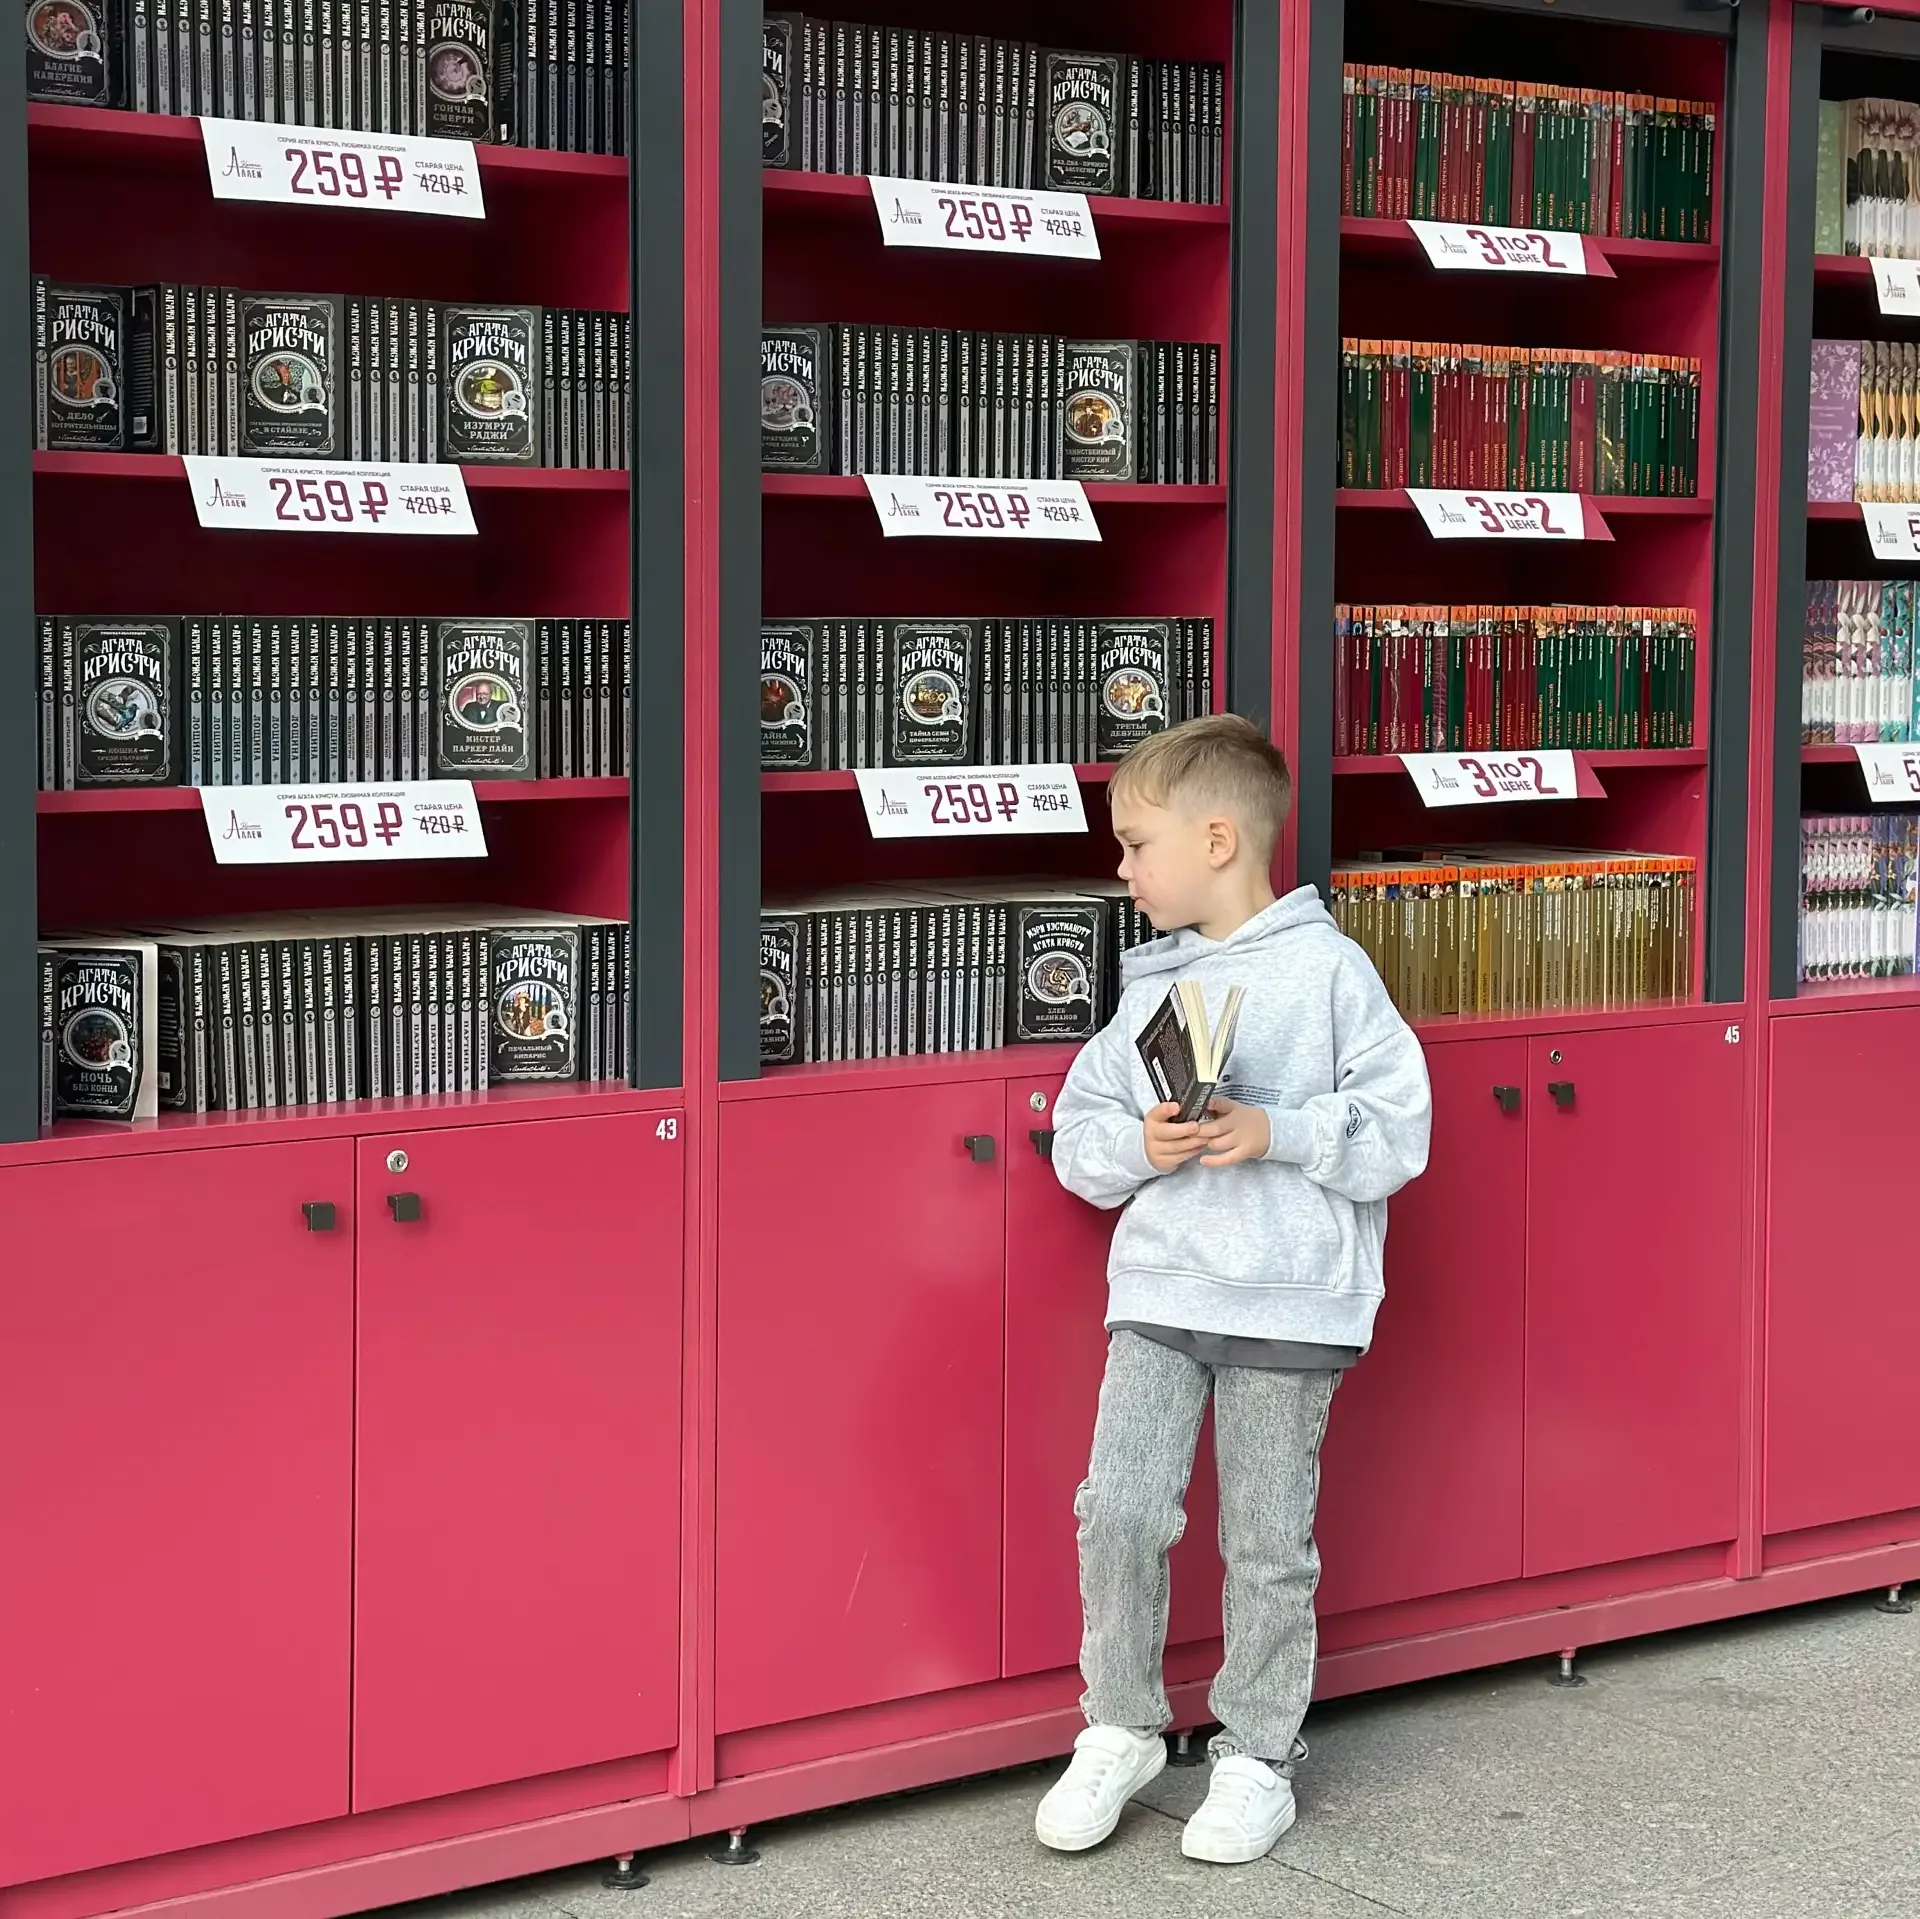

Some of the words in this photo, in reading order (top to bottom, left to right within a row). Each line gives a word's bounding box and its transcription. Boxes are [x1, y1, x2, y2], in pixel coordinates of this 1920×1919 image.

[436, 2, 472, 21] АГАТА
[430, 17, 486, 50] РИСТИ
[44, 60, 83, 74] БЛАГИЕ
[1065, 68, 1098, 82] АГАТА
[33, 70, 93, 86] НАМЕРЕНИЯ
[1053, 80, 1110, 108] КРИСТИ
[434, 102, 474, 116] ГОНЧАЯ
[433, 113, 475, 124] СМЕРТИ
[415, 161, 443, 170] СТАРАЯ
[444, 163, 464, 171] ЦЕНА
[1466, 229, 1506, 265] 3
[1526, 234, 1568, 268] 2
[1507, 252, 1542, 264] ЦЕНЕ
[58, 304, 99, 320] АГАТА
[166, 294, 175, 320] АГАТА
[266, 312, 308, 328] АГАТА
[51, 319, 116, 350] РИСТИ
[166, 322, 175, 354] КРИСТИ
[468, 322, 509, 338] АГАТА
[249, 325, 325, 357] КРИСТИ
[762, 339, 798, 354] АГАТА
[452, 334, 526, 365] КРИСТИ
[1072, 356, 1109, 370] АГАТА
[1066, 368, 1124, 394] РИСТИ
[67, 411, 94, 422] ДЕЛО
[464, 421, 514, 432] ИЗУМРУД
[470, 430, 508, 440] РАДЖИ
[1465, 496, 1504, 532] 3
[1524, 497, 1566, 534] 2
[1506, 519, 1540, 531] ЦЕНЕ
[101, 638, 144, 654] АГАТА
[192, 629, 201, 654] АГАТА
[290, 630, 300, 654] АГАТА
[464, 636, 504, 651] АГАТА
[761, 638, 790, 652] ГАТА
[916, 636, 950, 650] АГАТА
[1114, 636, 1148, 649] АГАТА
[84, 651, 160, 683] КРИСТИ
[447, 648, 520, 678] КРИСТИ
[902, 648, 964, 674] КРИСТИ
[1101, 646, 1162, 672] КРИСТИ
[192, 656, 201, 688] КРИСТИ
[290, 656, 300, 688] КРИСТИ
[192, 716, 200, 763] ЛОЩИНА
[466, 736, 502, 744] МИСТЕР
[108, 747, 138, 755] КОШКА
[452, 744, 488, 754] ПАРКЕР
[488, 744, 514, 753] ПАЙН
[1458, 758, 1498, 797] 3
[1518, 757, 1559, 794] 2
[1499, 780, 1533, 793] ЦЕНЕ
[1026, 924, 1046, 939] МЭРИ
[1046, 922, 1092, 938] УЭСТМАКОТТ
[512, 943, 552, 958] АГАТА
[1032, 938, 1056, 952] АГАТА
[1056, 937, 1084, 952] КРИСТИ
[412, 944, 420, 968] АГАТА
[479, 942, 488, 966] АГАТА
[78, 968, 118, 984] АГАТА
[496, 956, 569, 986] КРИСТИ
[412, 970, 420, 1001] КРИСТИ
[479, 968, 488, 998] КРИСТИ
[61, 982, 132, 1014] КРИСТИ
[1724, 1025, 1740, 1044] 45
[80, 1072, 113, 1084] НОЧЬ
[72, 1082, 89, 1092] БЕЗ
[90, 1083, 118, 1094] КОНЦА
[655, 1118, 678, 1140] 43
